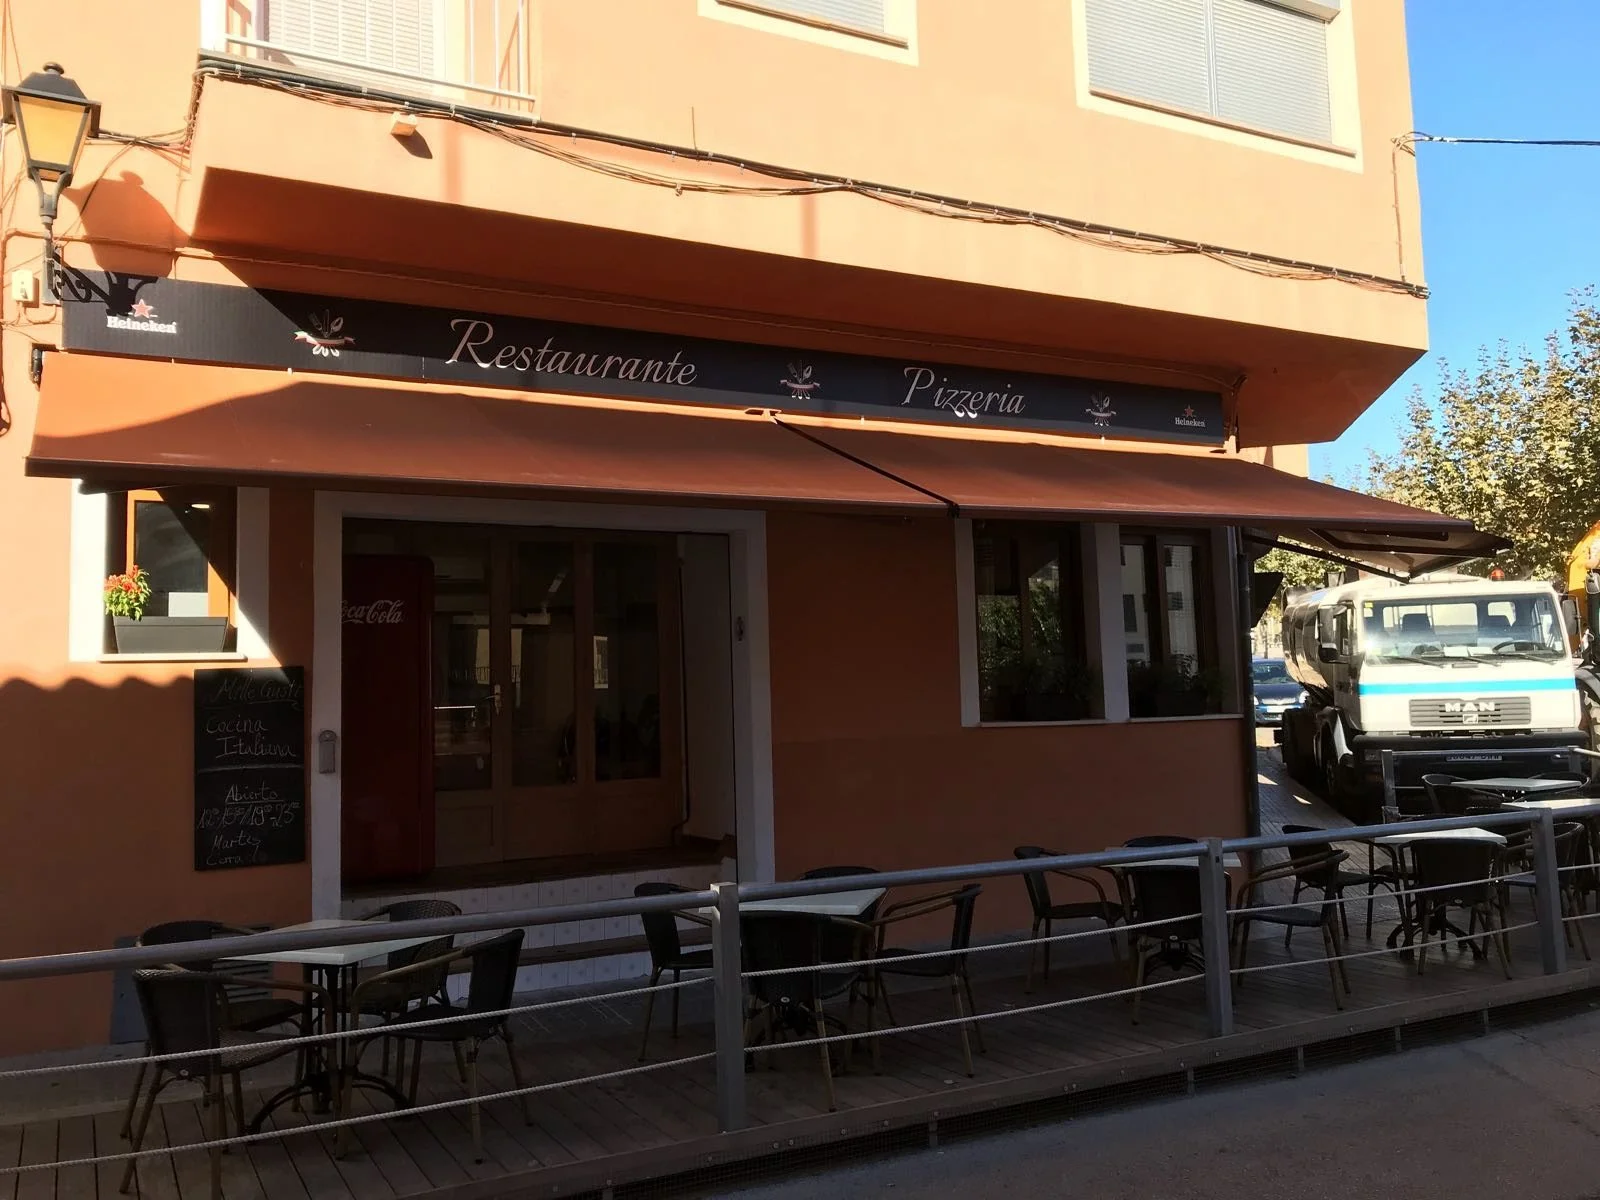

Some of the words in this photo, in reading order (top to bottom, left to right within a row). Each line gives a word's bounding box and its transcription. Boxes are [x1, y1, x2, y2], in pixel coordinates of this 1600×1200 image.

[106, 315, 177, 333] Heineken
[445, 318, 697, 385] Restaurante
[901, 367, 1026, 419] Pizzeria
[1174, 417, 1206, 428] Heineken
[1445, 702, 1495, 712] MAN
[206, 714, 268, 733] Cocina
[216, 731, 297, 758] Italiana
[225, 780, 279, 803] Abierto
